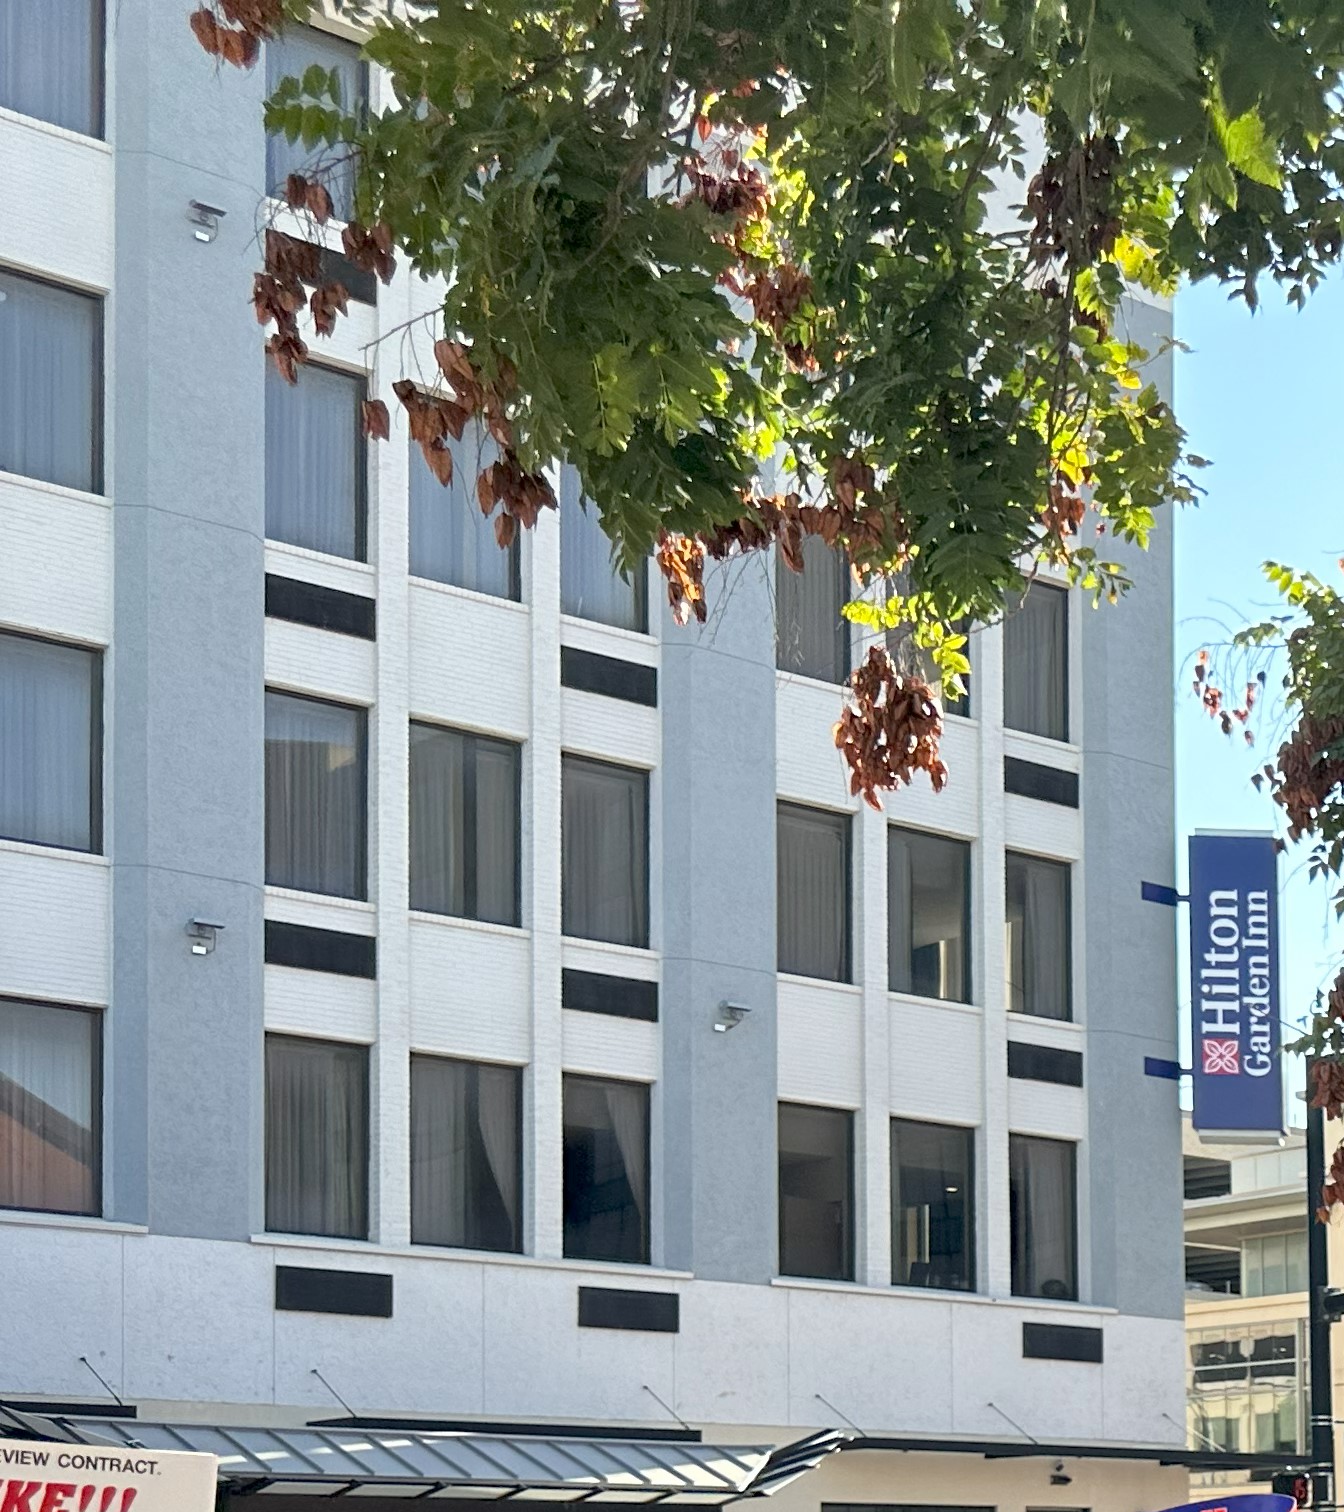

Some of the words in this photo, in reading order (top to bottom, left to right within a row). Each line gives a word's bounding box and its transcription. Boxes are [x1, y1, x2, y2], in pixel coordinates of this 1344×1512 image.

[1200, 889, 1240, 1035] Hilton
[1241, 890, 1269, 949] Inn
[1243, 953, 1272, 1077] Garden
[0, 1448, 50, 1466] VIEW
[57, 1453, 162, 1476] CONTRACT.
